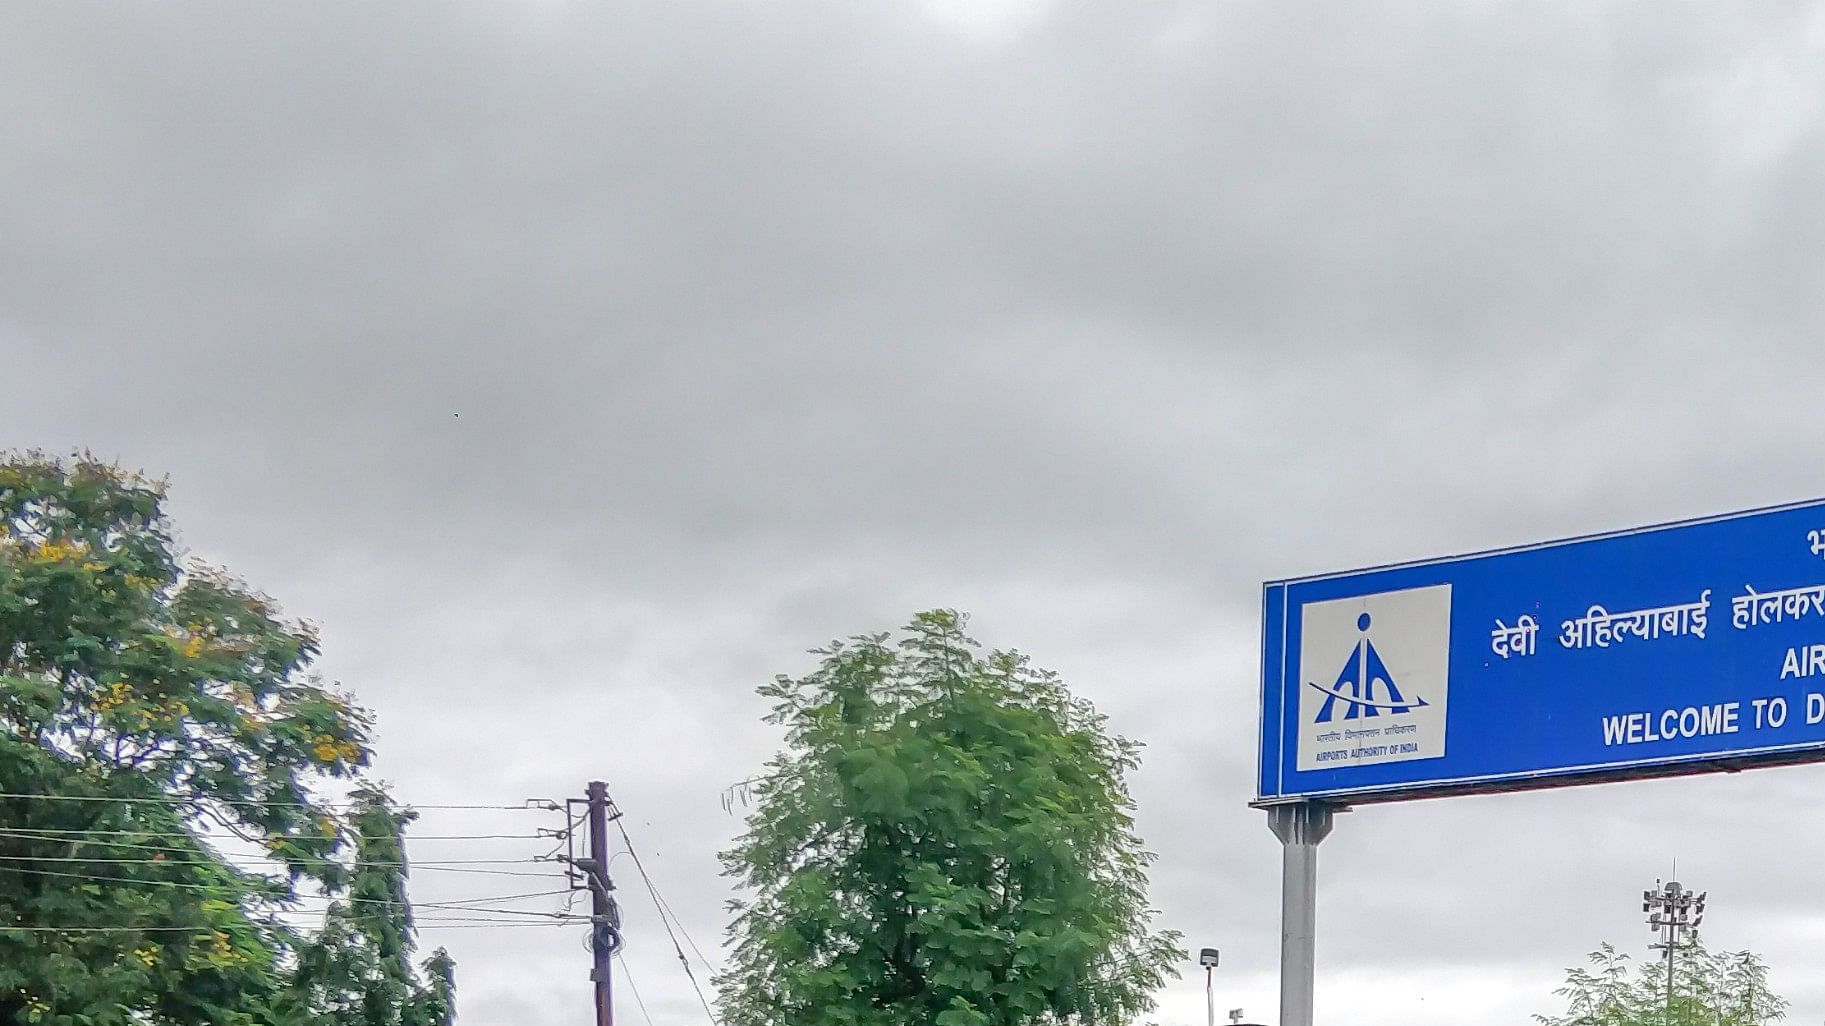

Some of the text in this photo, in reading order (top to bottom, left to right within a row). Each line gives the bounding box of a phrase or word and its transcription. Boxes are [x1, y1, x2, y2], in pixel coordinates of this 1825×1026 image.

[1491, 613, 1540, 659] देवी
[1558, 589, 1712, 650] अहिल्याबाई
[1602, 702, 1740, 748] WELCOME
[1751, 696, 1788, 731] TO
[1316, 742, 1418, 762] AIRPORTS AUTHORITY OF INDIA
